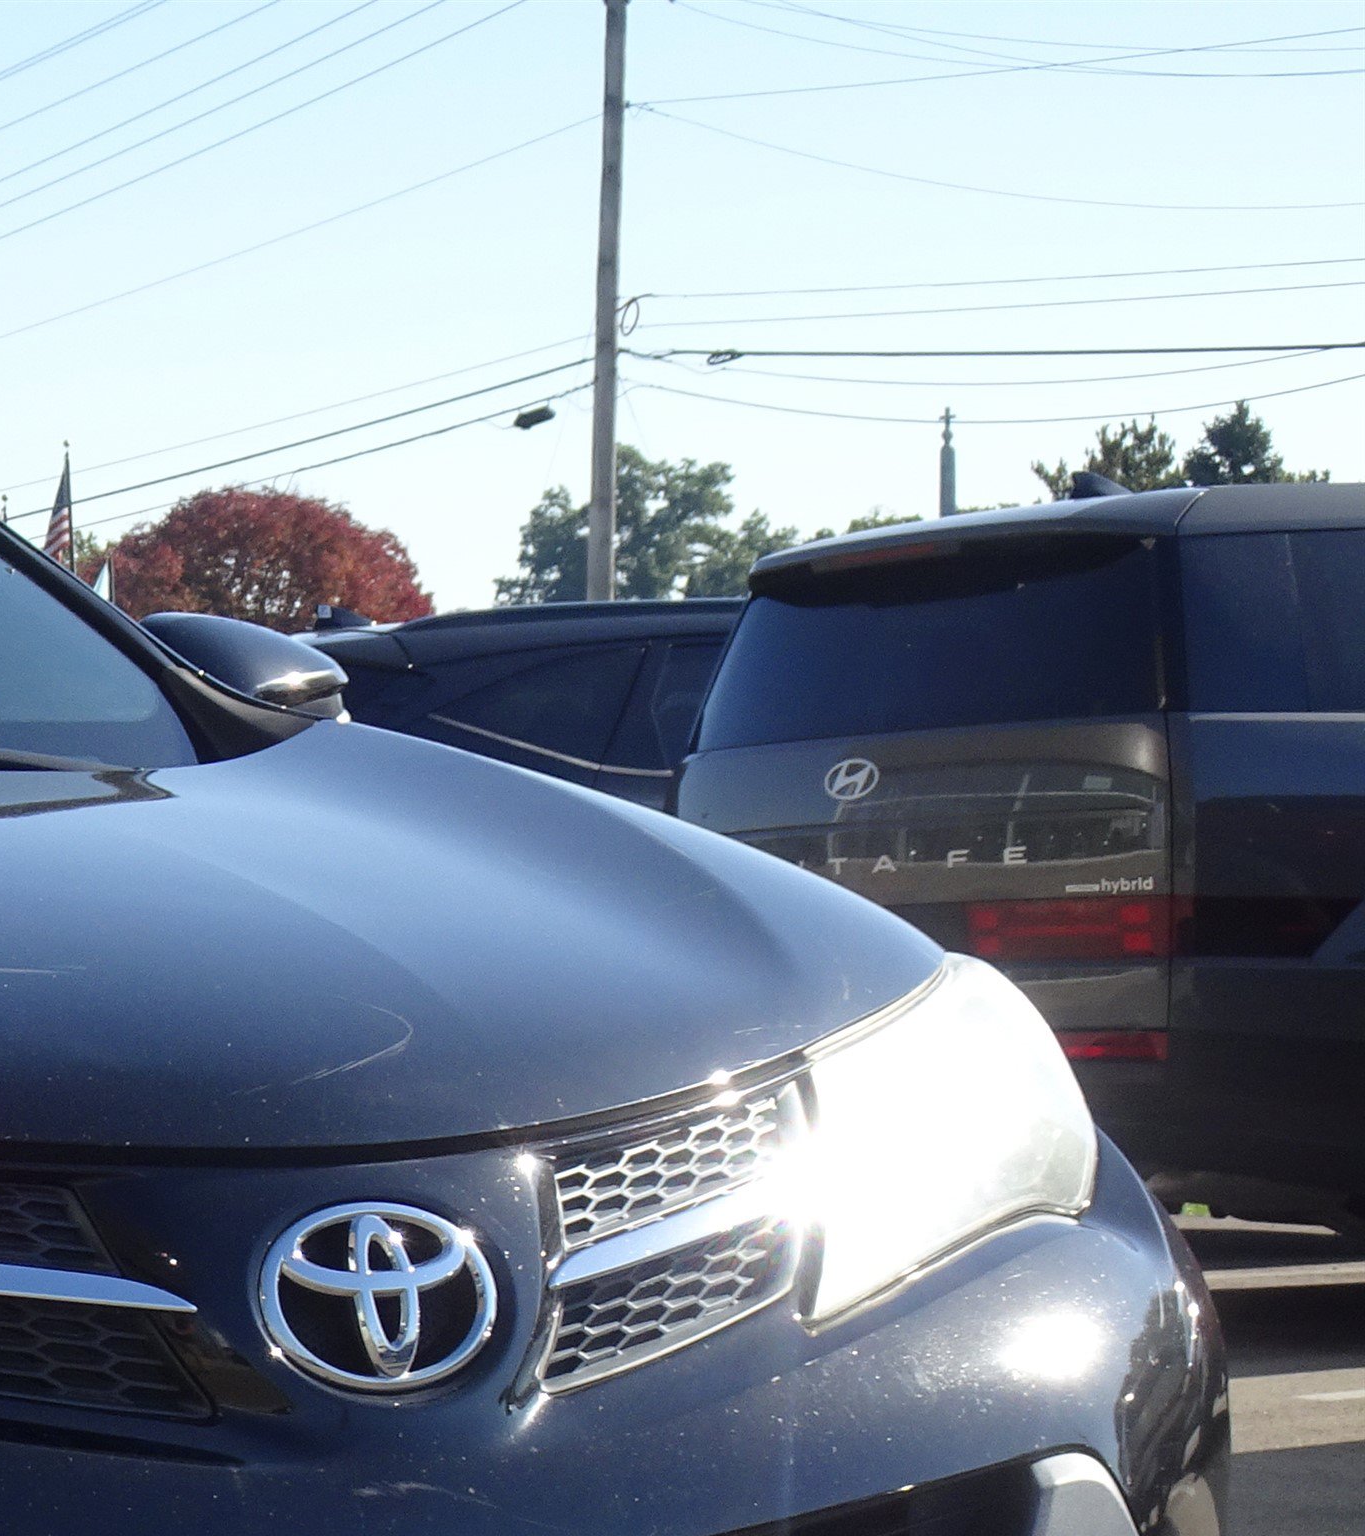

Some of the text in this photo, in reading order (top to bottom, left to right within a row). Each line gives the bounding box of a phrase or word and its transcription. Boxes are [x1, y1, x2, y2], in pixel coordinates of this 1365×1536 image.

[798, 845, 1028, 876] TA FE
[1100, 876, 1154, 895] hybrid
